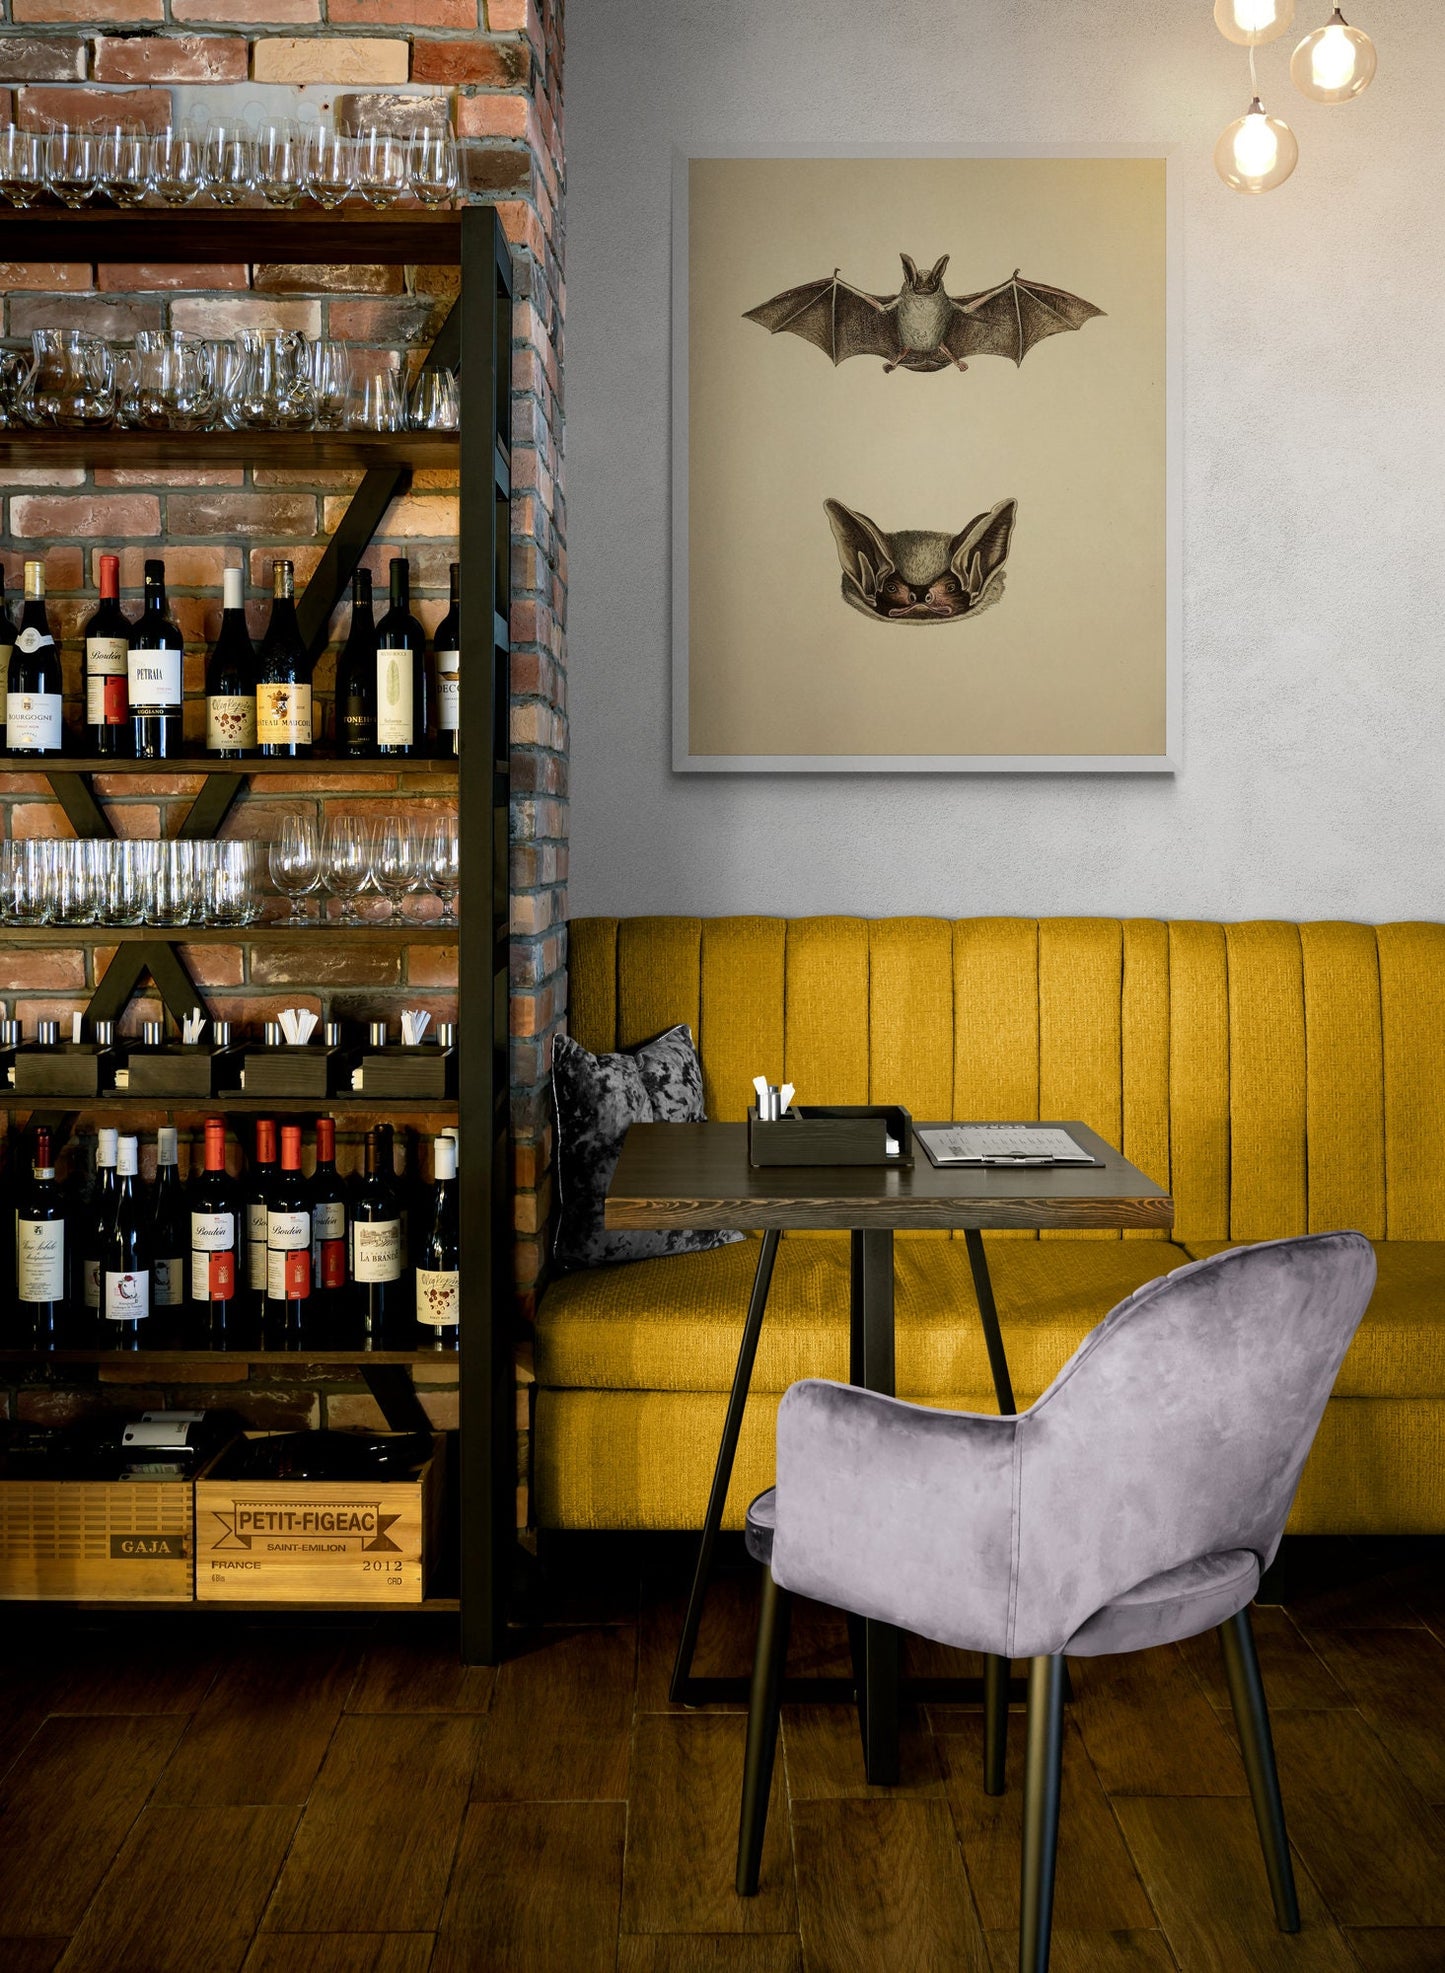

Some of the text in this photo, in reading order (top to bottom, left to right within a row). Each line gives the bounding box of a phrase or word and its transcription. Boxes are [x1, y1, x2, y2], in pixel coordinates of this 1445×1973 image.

[136, 668, 163, 680] PETRAIA
[196, 1226, 226, 1235] Bordón
[273, 1226, 302, 1235] Bordón
[360, 1252, 370, 1262] LA
[240, 1512, 375, 1532] PETIT-FIGEAC
[121, 1541, 172, 1553] GAJA
[267, 1543, 346, 1552] SAINT-EMILION
[211, 1560, 261, 1569] FRANCE
[363, 1560, 403, 1572] 2012
